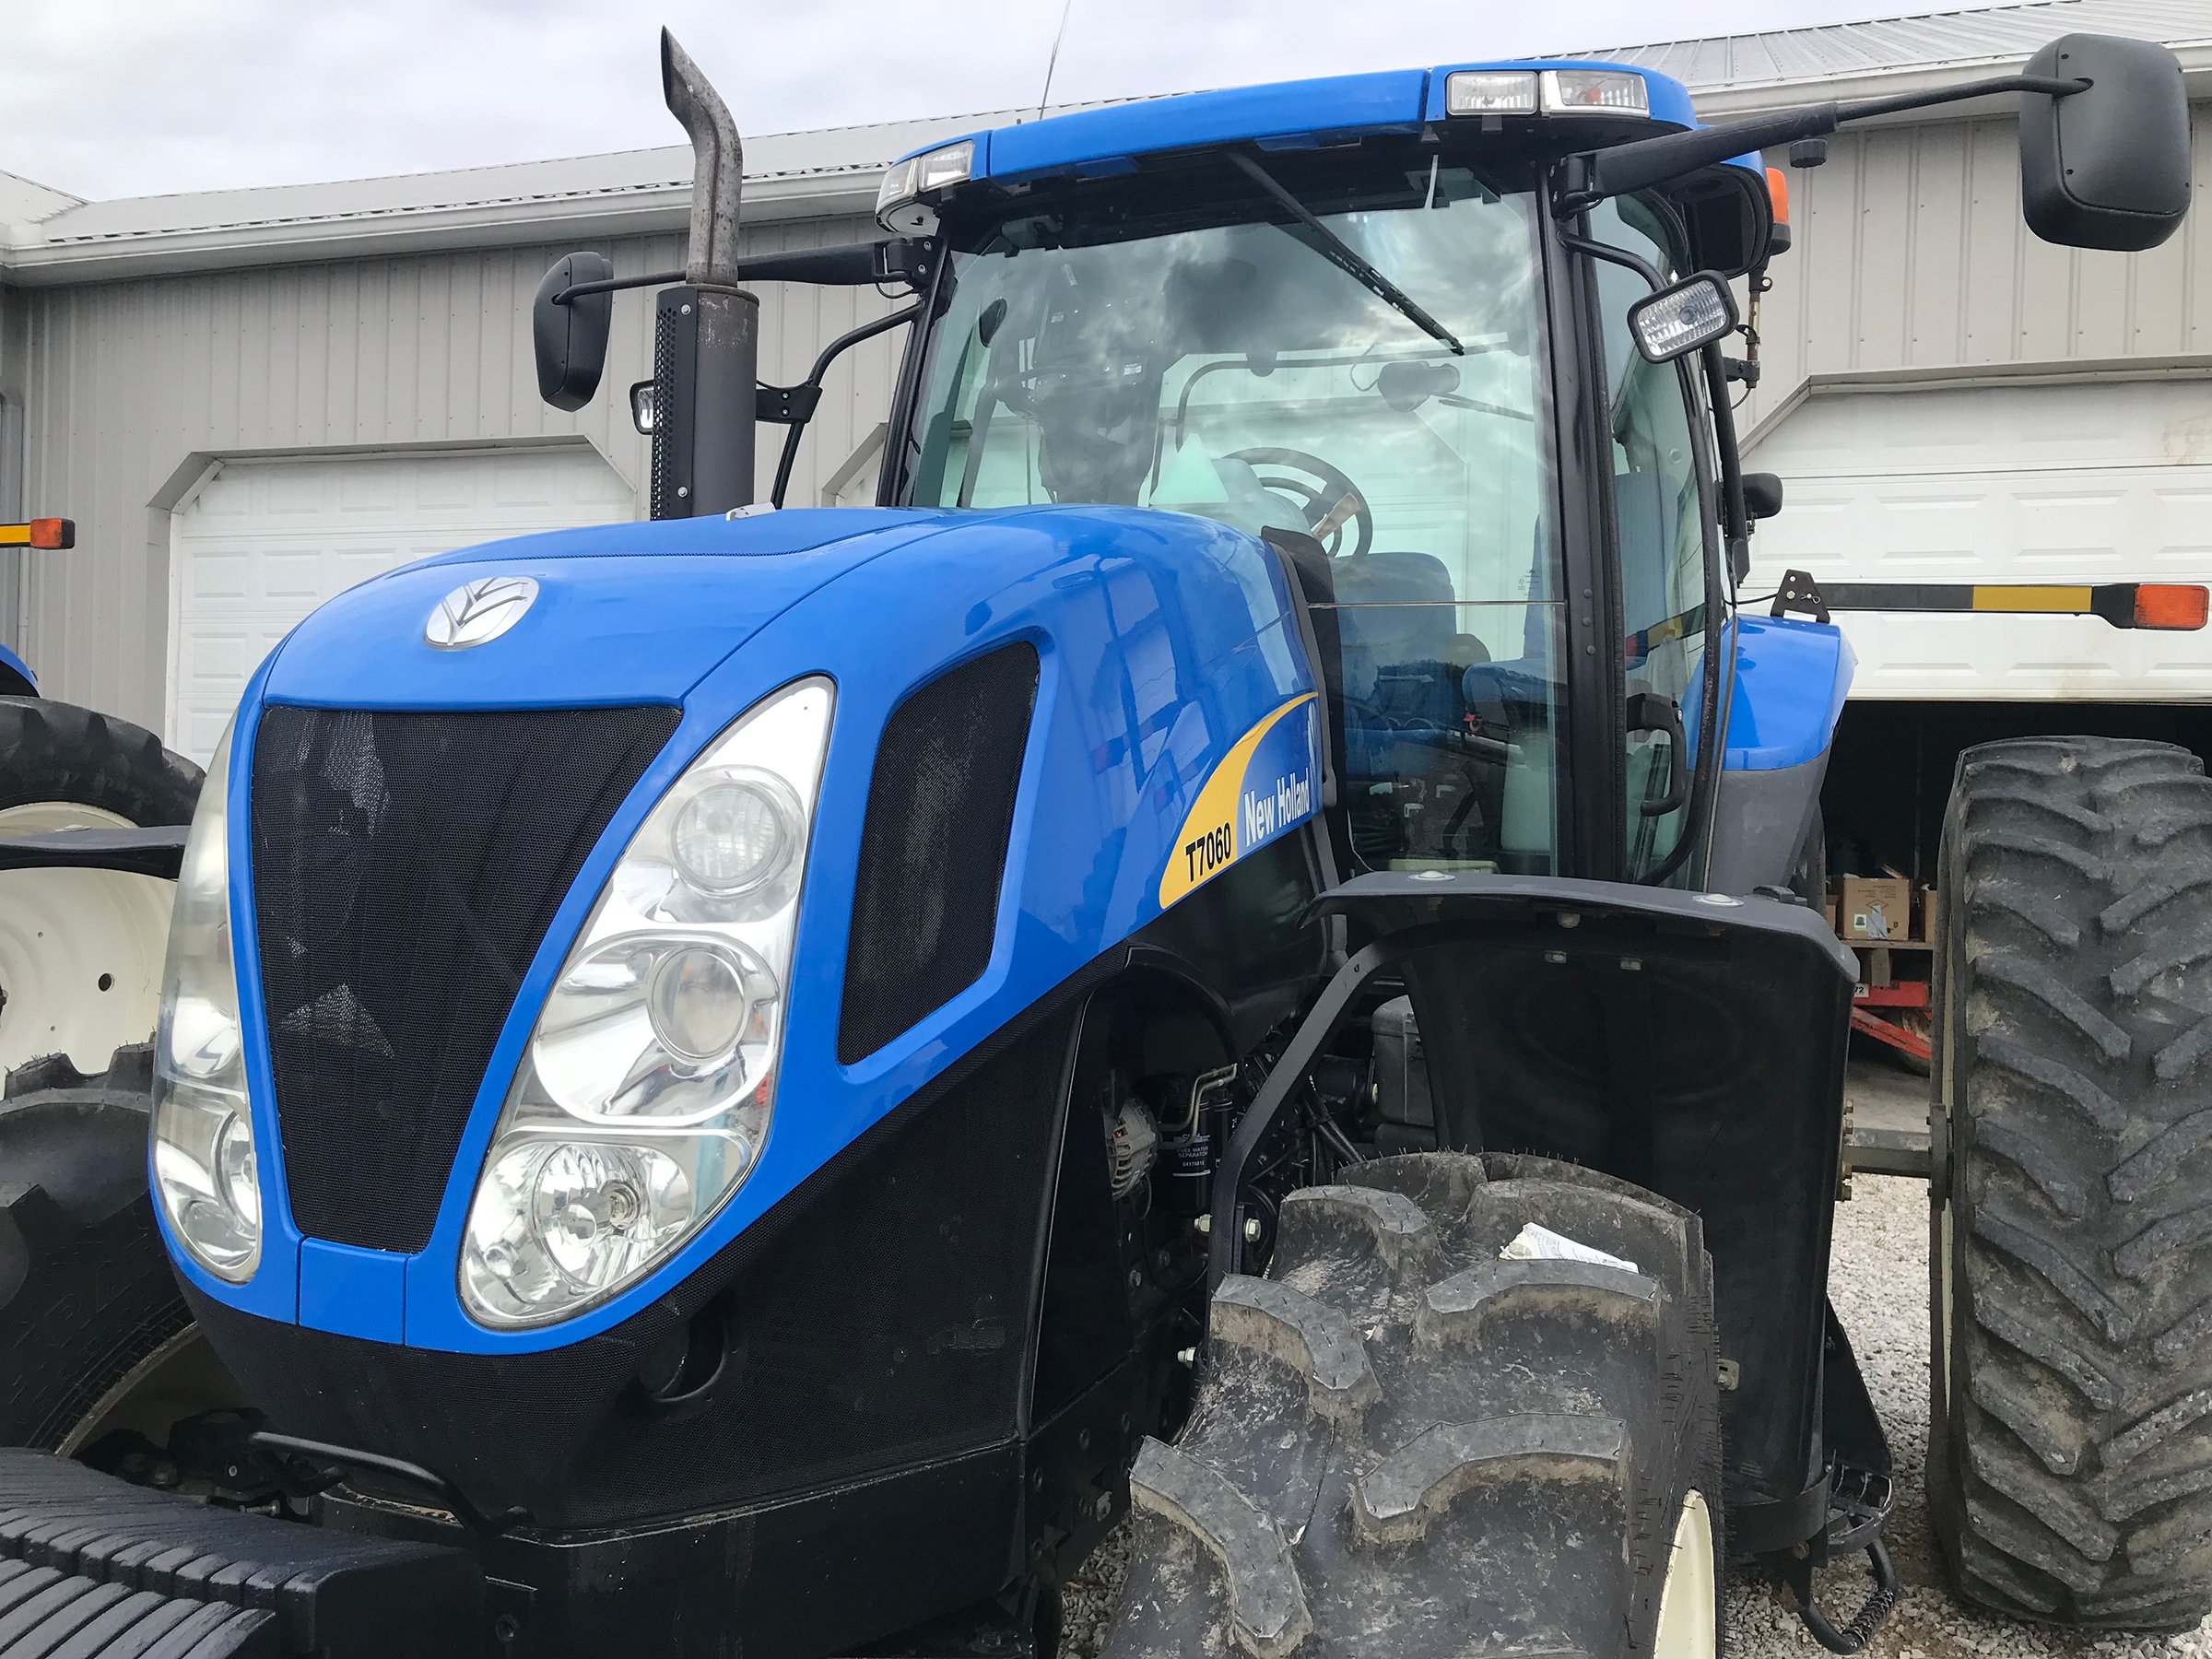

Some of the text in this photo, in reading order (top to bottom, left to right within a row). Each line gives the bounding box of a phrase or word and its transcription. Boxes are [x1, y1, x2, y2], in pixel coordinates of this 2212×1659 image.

[1244, 768, 1310, 847] New Holland
[1185, 822, 1231, 882] T7060
